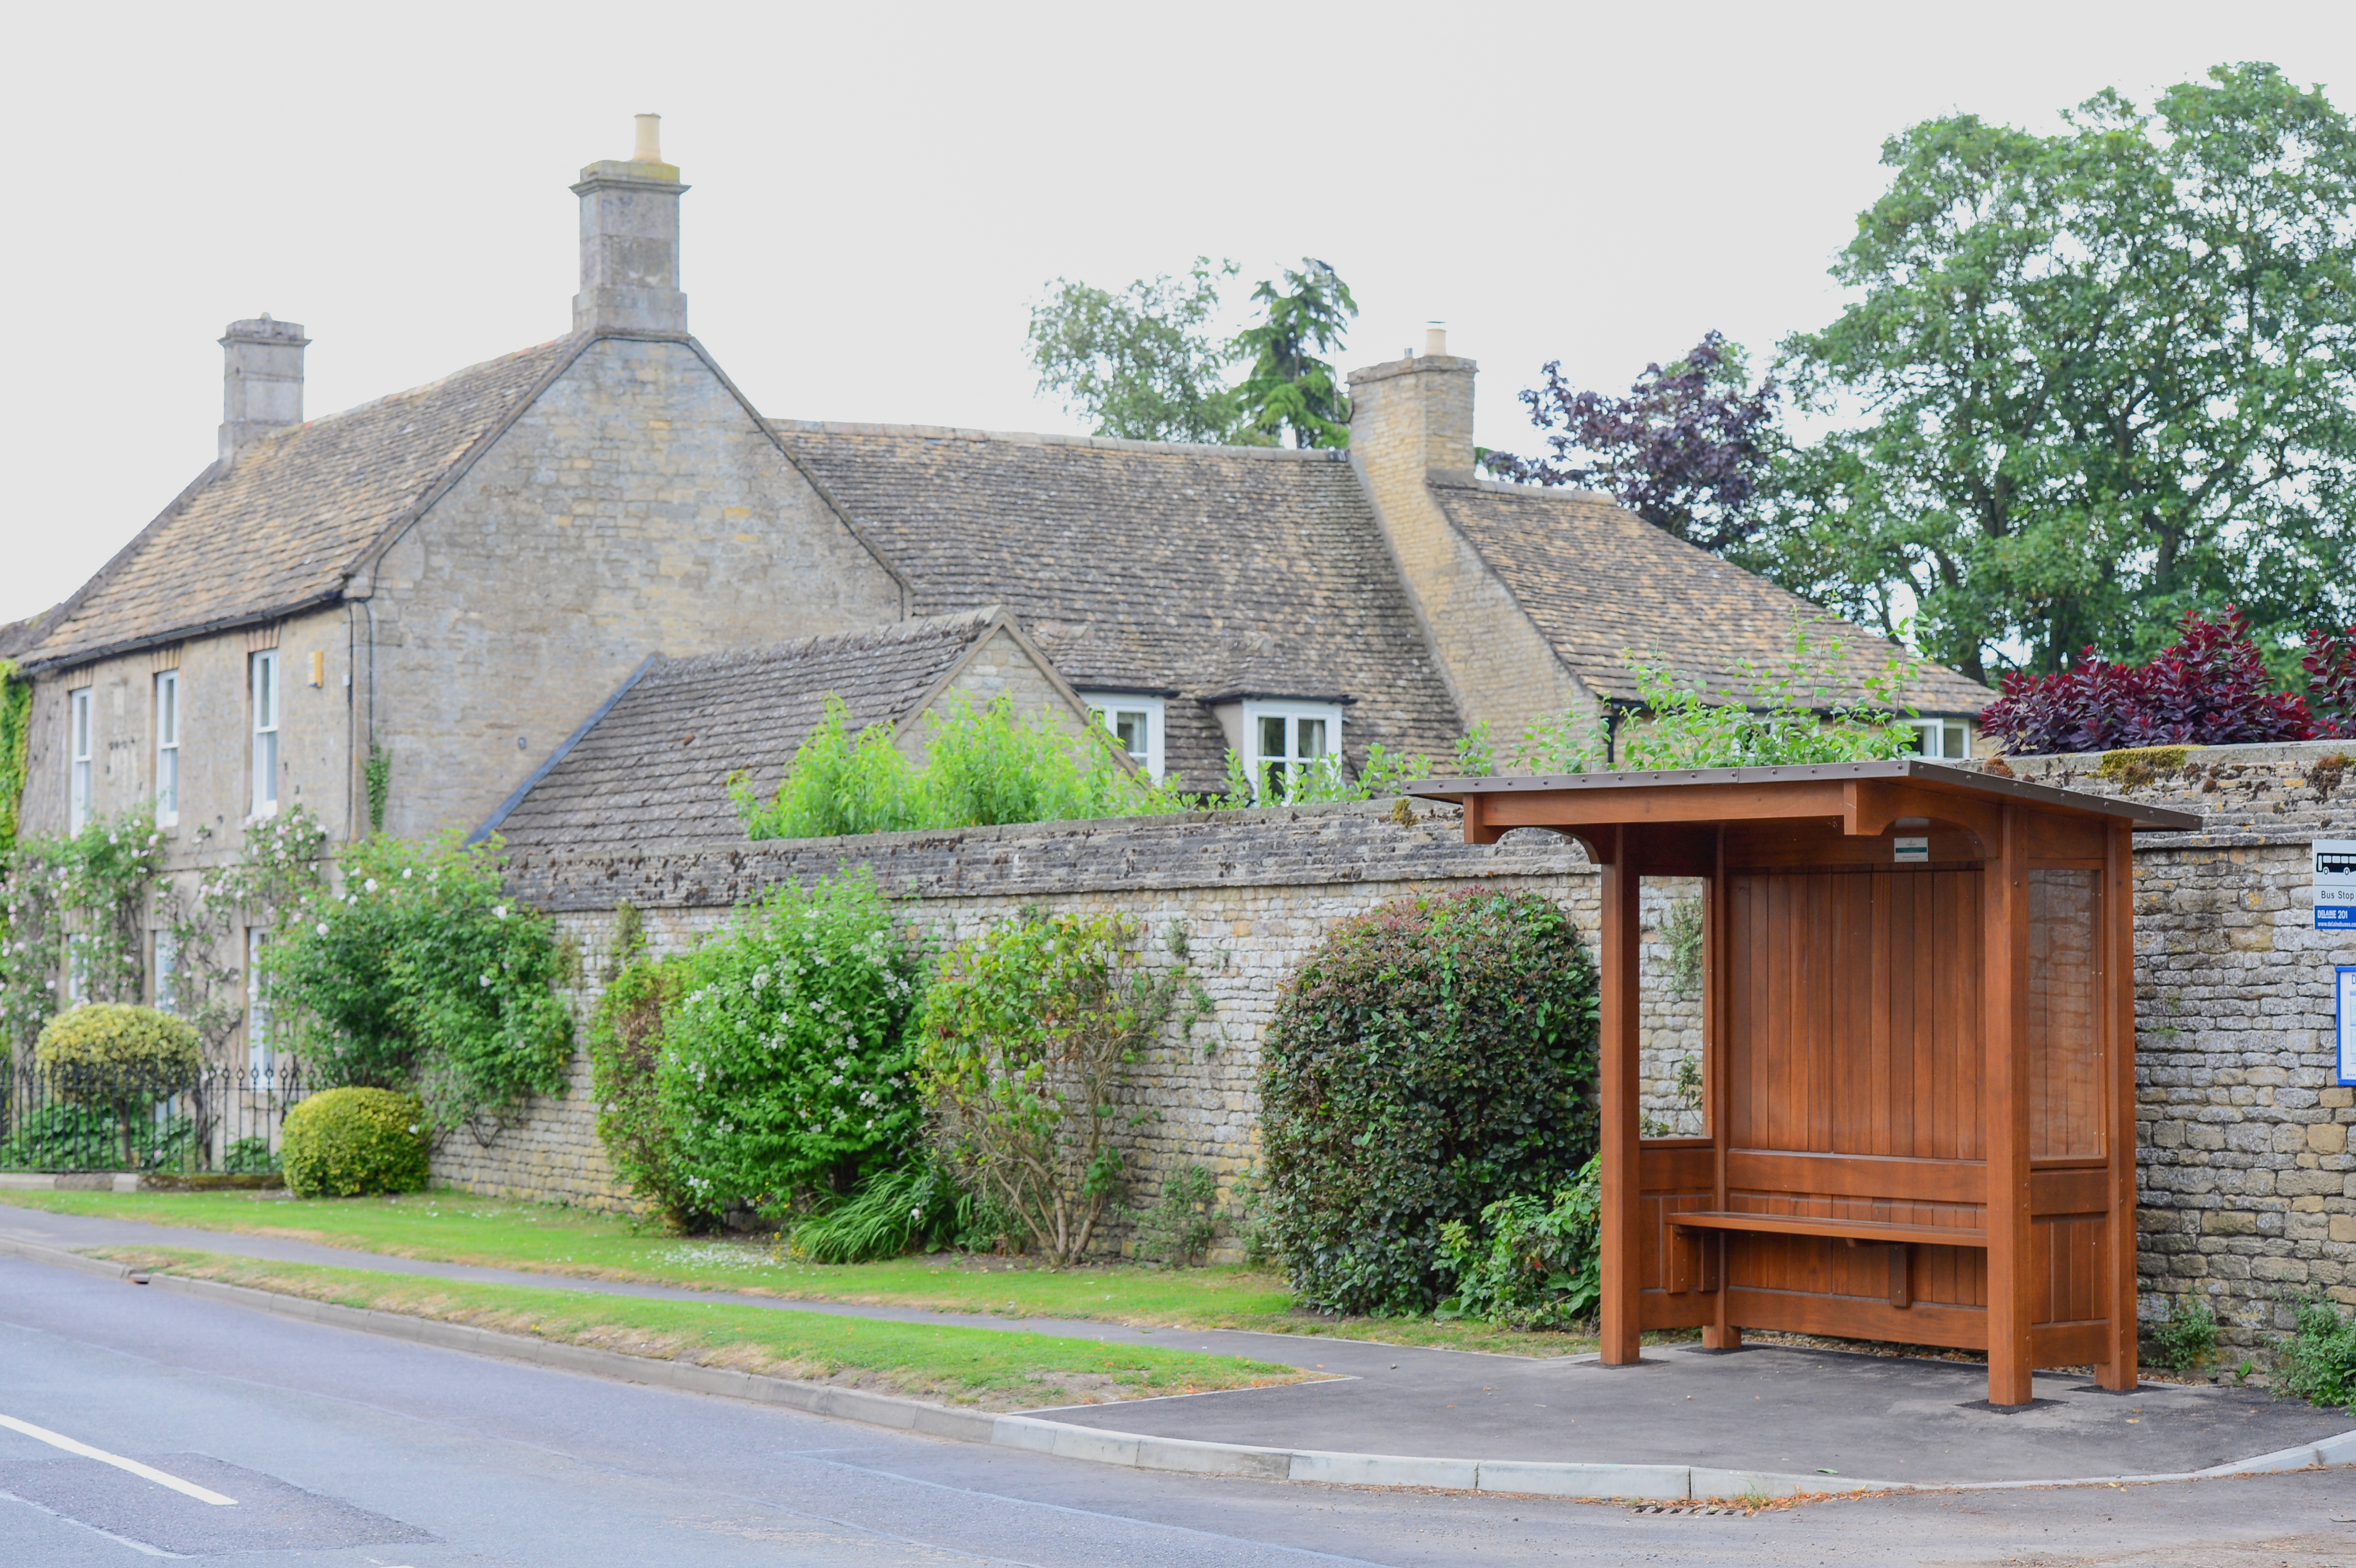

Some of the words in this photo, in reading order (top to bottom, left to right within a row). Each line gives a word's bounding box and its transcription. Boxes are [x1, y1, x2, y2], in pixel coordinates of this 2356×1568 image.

[2321, 891, 2334, 899] Bus
[2338, 891, 2354, 902] Stop
[2317, 910, 2337, 919] DELAINE
[2338, 910, 2348, 919] 201
